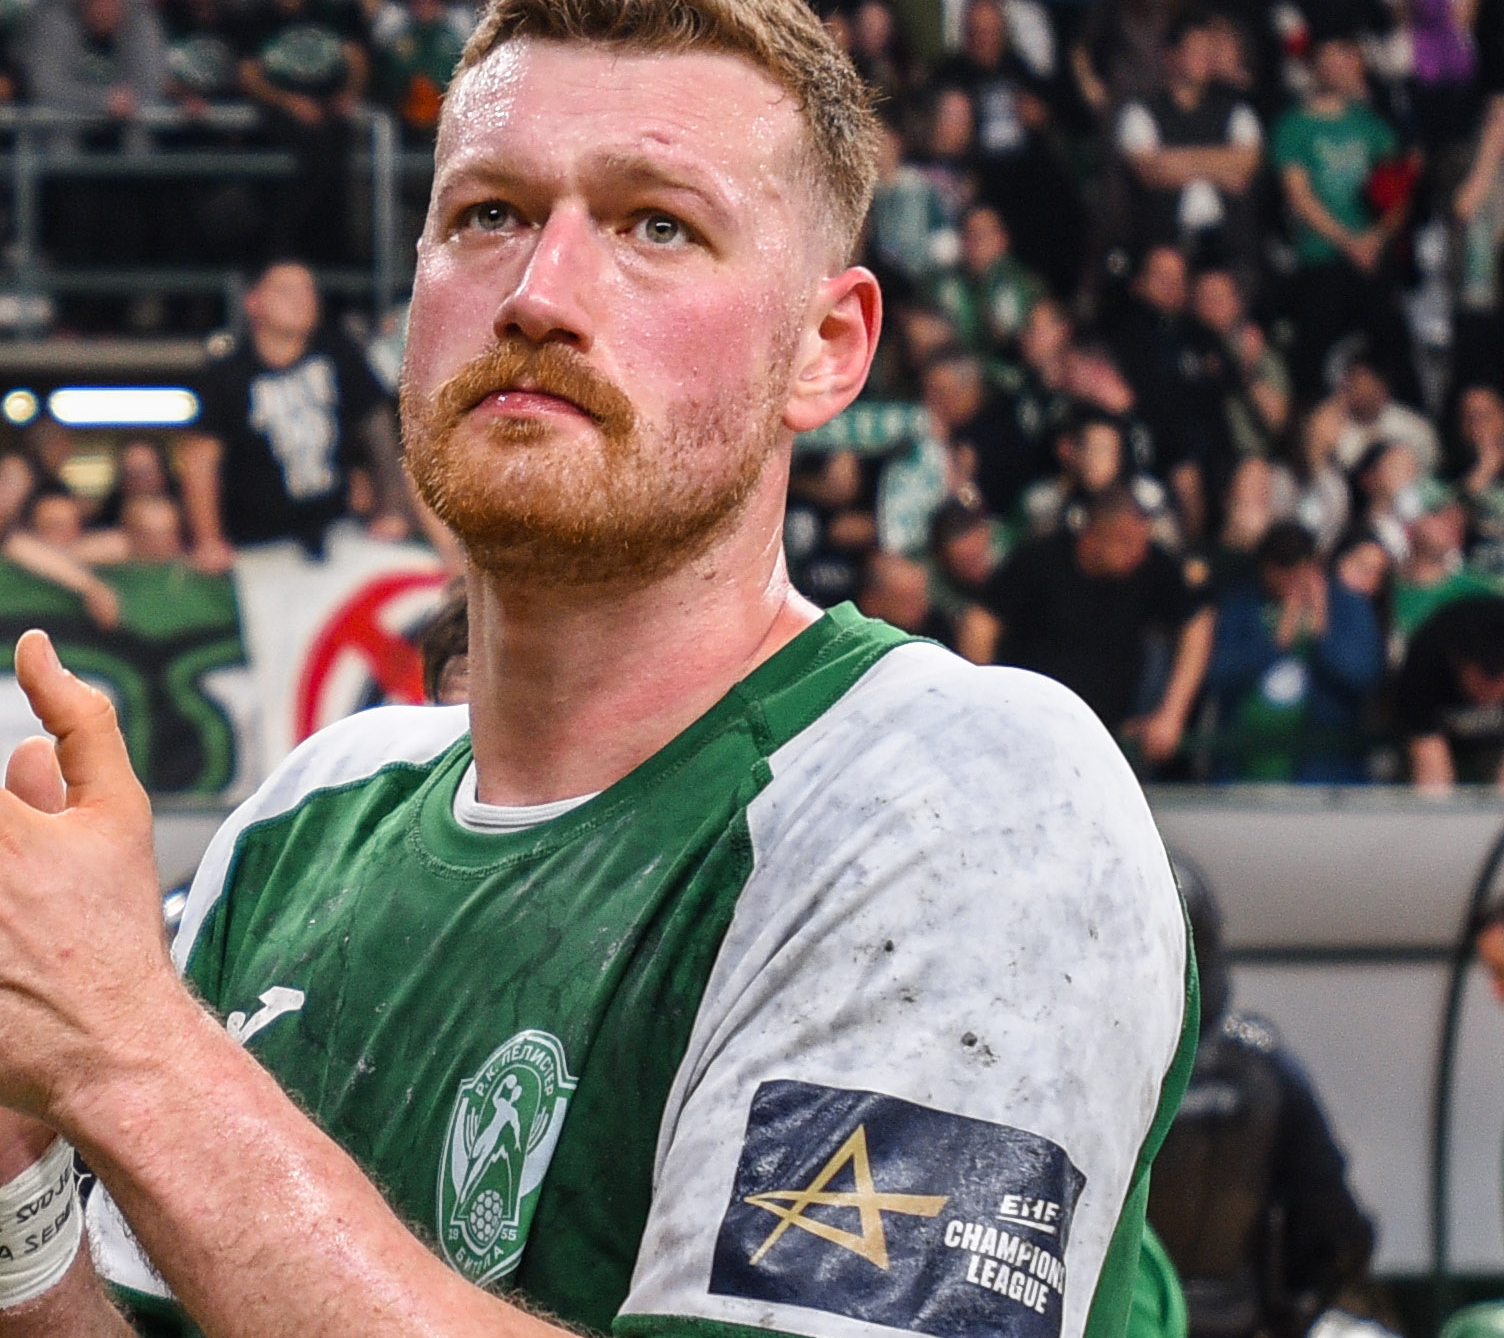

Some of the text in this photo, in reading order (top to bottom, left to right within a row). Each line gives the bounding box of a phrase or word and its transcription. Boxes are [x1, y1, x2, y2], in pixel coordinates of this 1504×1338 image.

[501, 1044, 554, 1097] ПЕЛИСТЕР
[999, 1194, 1060, 1222] EHF
[500, 1228, 517, 1241] 55
[965, 1253, 1050, 1315] LEAGUE
